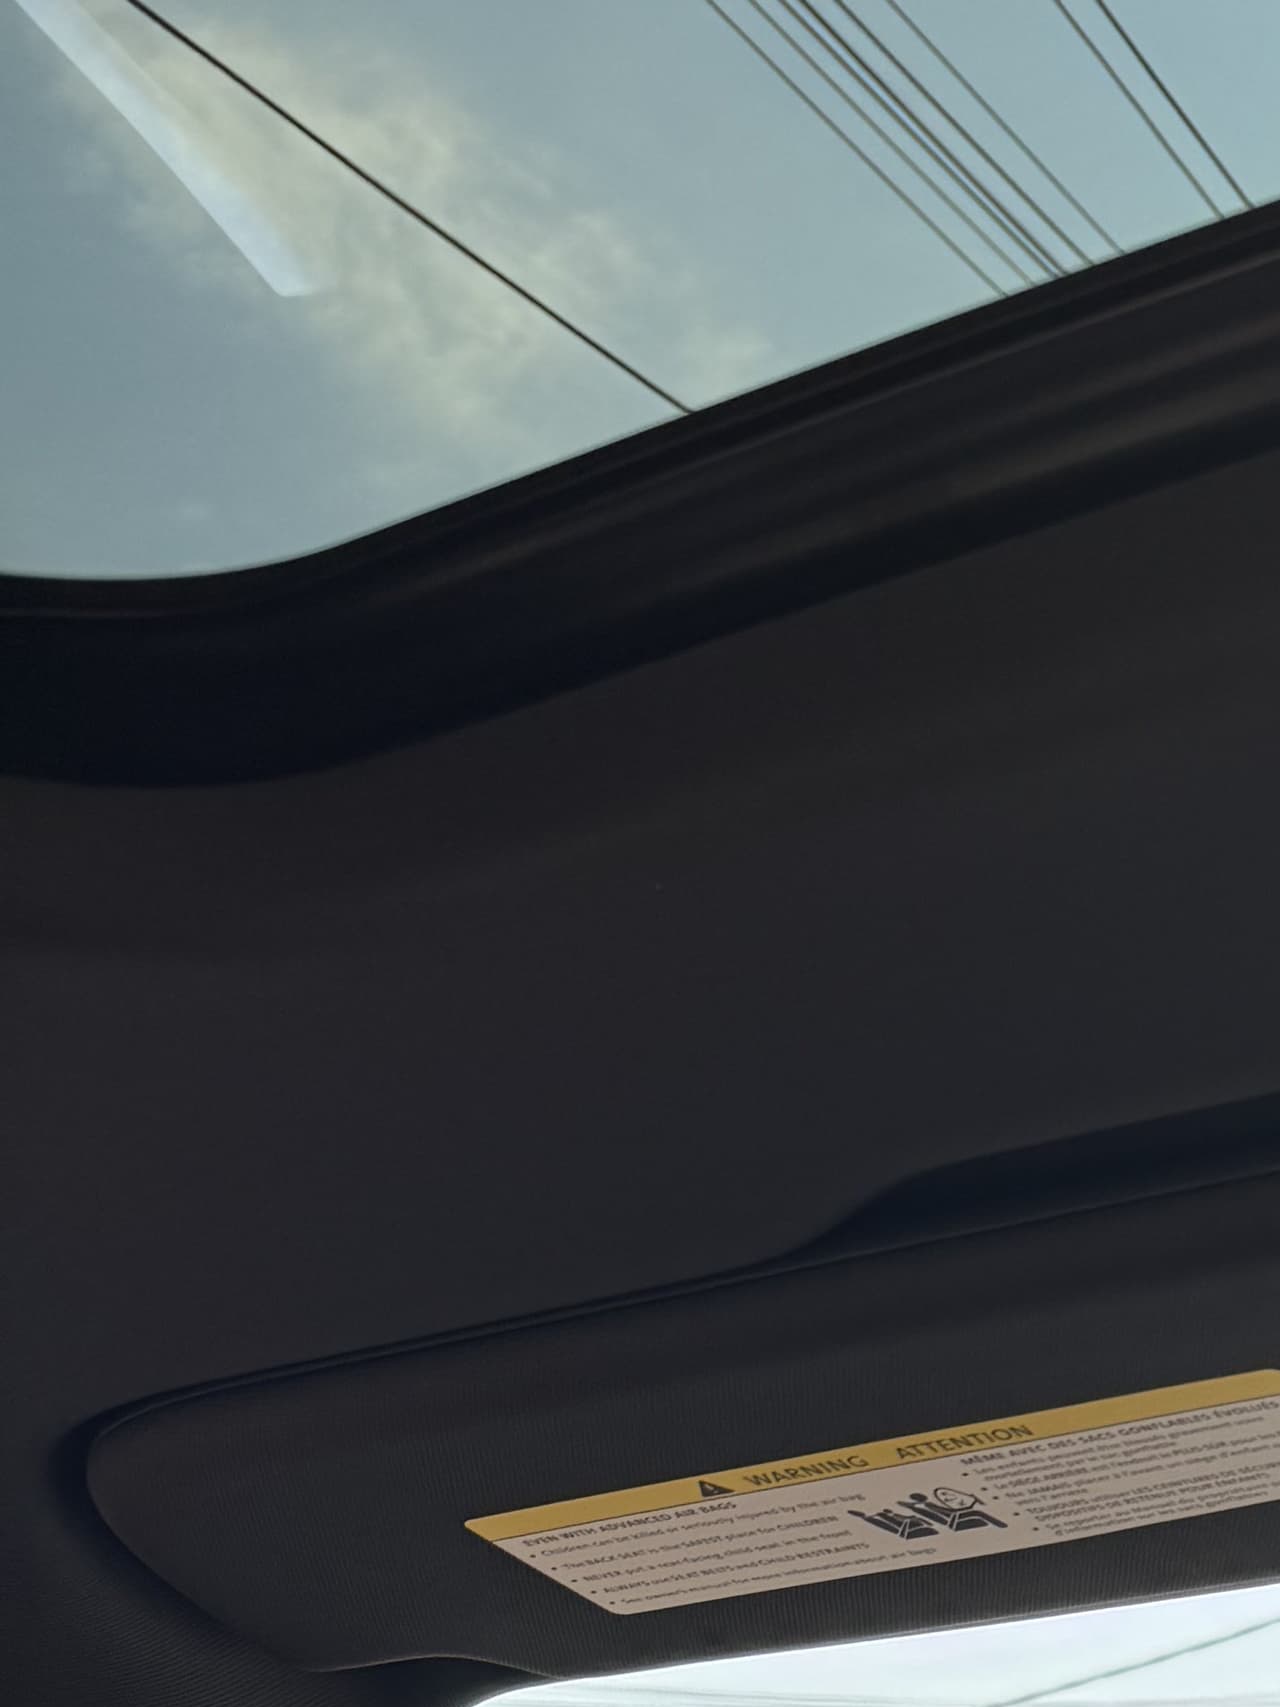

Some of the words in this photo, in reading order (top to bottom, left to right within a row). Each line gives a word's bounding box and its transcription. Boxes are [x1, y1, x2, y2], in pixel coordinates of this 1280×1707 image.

[744, 1456, 868, 1485] WARNING
[897, 1426, 1032, 1458] ATTENTION
[522, 1535, 559, 1546] EVEN
[560, 1528, 596, 1538] WITH
[600, 1514, 671, 1531] ADVANCED
[675, 1509, 697, 1518] AIR
[699, 1502, 736, 1513] BAGS
